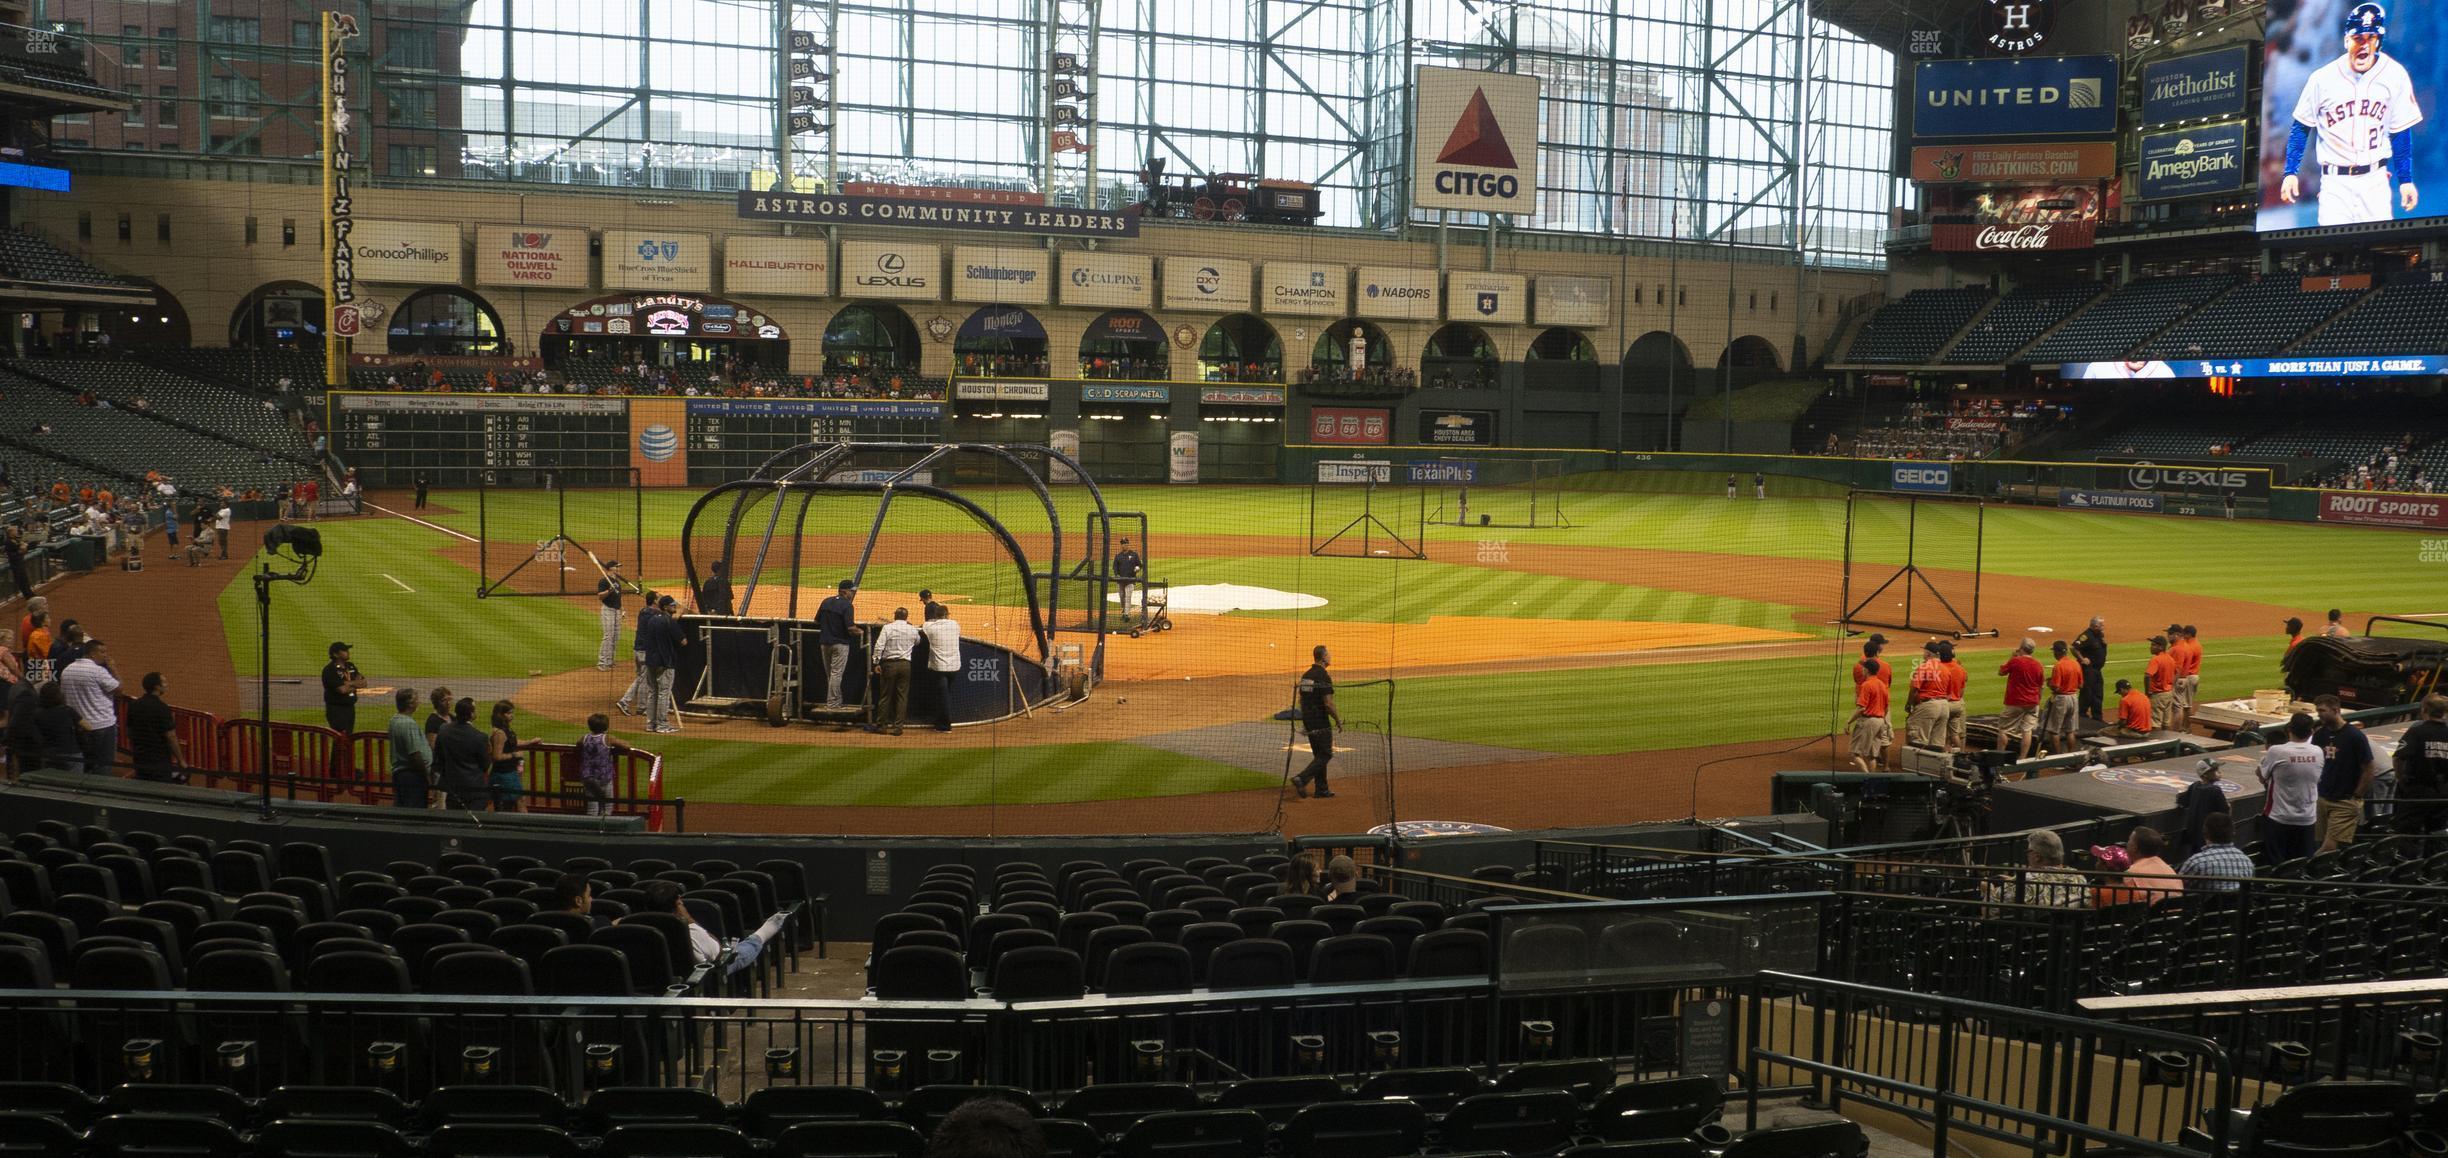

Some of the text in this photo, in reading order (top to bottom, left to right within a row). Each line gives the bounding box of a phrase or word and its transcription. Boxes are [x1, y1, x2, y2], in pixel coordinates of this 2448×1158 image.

[2003, 4, 2031, 29] H
[794, 36, 809, 47] 80
[1989, 32, 2043, 51] ASTROS
[794, 63, 809, 74] 86
[1057, 58, 1072, 69] 99
[1057, 84, 1071, 94] 01
[2150, 70, 2237, 101] Methodist
[793, 91, 808, 101] 97
[1928, 86, 2060, 107] UNITED
[1057, 109, 1072, 120] 04
[2326, 98, 2388, 128] ASTROS
[793, 117, 809, 128] 98
[1057, 136, 1072, 147] 05
[1972, 149, 2078, 162] FREE Daily Fantasy Baseball
[1972, 161, 2078, 176] DRAFTKINGS.COM
[2147, 152, 2234, 180] AmegyBank
[1435, 170, 1519, 198] CITGO
[866, 186, 1027, 202] MINUTE MAID
[754, 197, 1127, 231] ASTROS COMMUNITY LEADERS
[1976, 224, 2053, 250] Coca-Cola
[334, 222, 351, 300] FARE
[358, 246, 449, 264] ConocoPhillips
[502, 250, 563, 262] NATIONAL
[507, 260, 558, 271] OILWELL
[657, 265, 698, 275] BlueShield
[729, 259, 825, 272] HALLIBURTON
[512, 270, 553, 280] VARCO
[966, 264, 1037, 284] Schlumberger
[1091, 272, 1142, 286] CALPINE
[1196, 276, 1220, 285] OXY
[856, 275, 926, 288] LEXUS
[1274, 285, 1336, 299] CHAMPION
[1382, 286, 1431, 299] NABORS
[635, 293, 705, 312] Landry's
[1303, 299, 1336, 307] SERVICES
[983, 312, 1024, 331] Montejo
[1108, 315, 1143, 329] ROOT
[2215, 366, 2227, 374] vs.
[2268, 360, 2426, 373] MORE THAN JUST A GAME.
[962, 385, 1044, 395] HOUSTON CHRONICLE
[1088, 388, 1096, 398] C
[1104, 388, 1111, 398] D
[1115, 389, 1139, 399] SCRAP
[1141, 390, 1164, 400] METAL
[304, 395, 326, 406] 315
[1318, 424, 1332, 433] 66
[1343, 424, 1356, 434] 66
[1367, 424, 1380, 434] 66
[1948, 418, 1998, 430] Budweiser
[1452, 435, 1476, 443] DEALERS
[1459, 429, 1475, 437] AREA
[1336, 465, 1389, 479] Inspety
[1411, 466, 1473, 481] TexanPlus
[1895, 468, 1949, 485] GEICO
[2163, 471, 2248, 488] LEXUS
[2091, 495, 2154, 509] PLATINUM POOLS
[2330, 495, 2440, 517] ROOT SPORTS
[2179, 506, 2196, 515] 373
